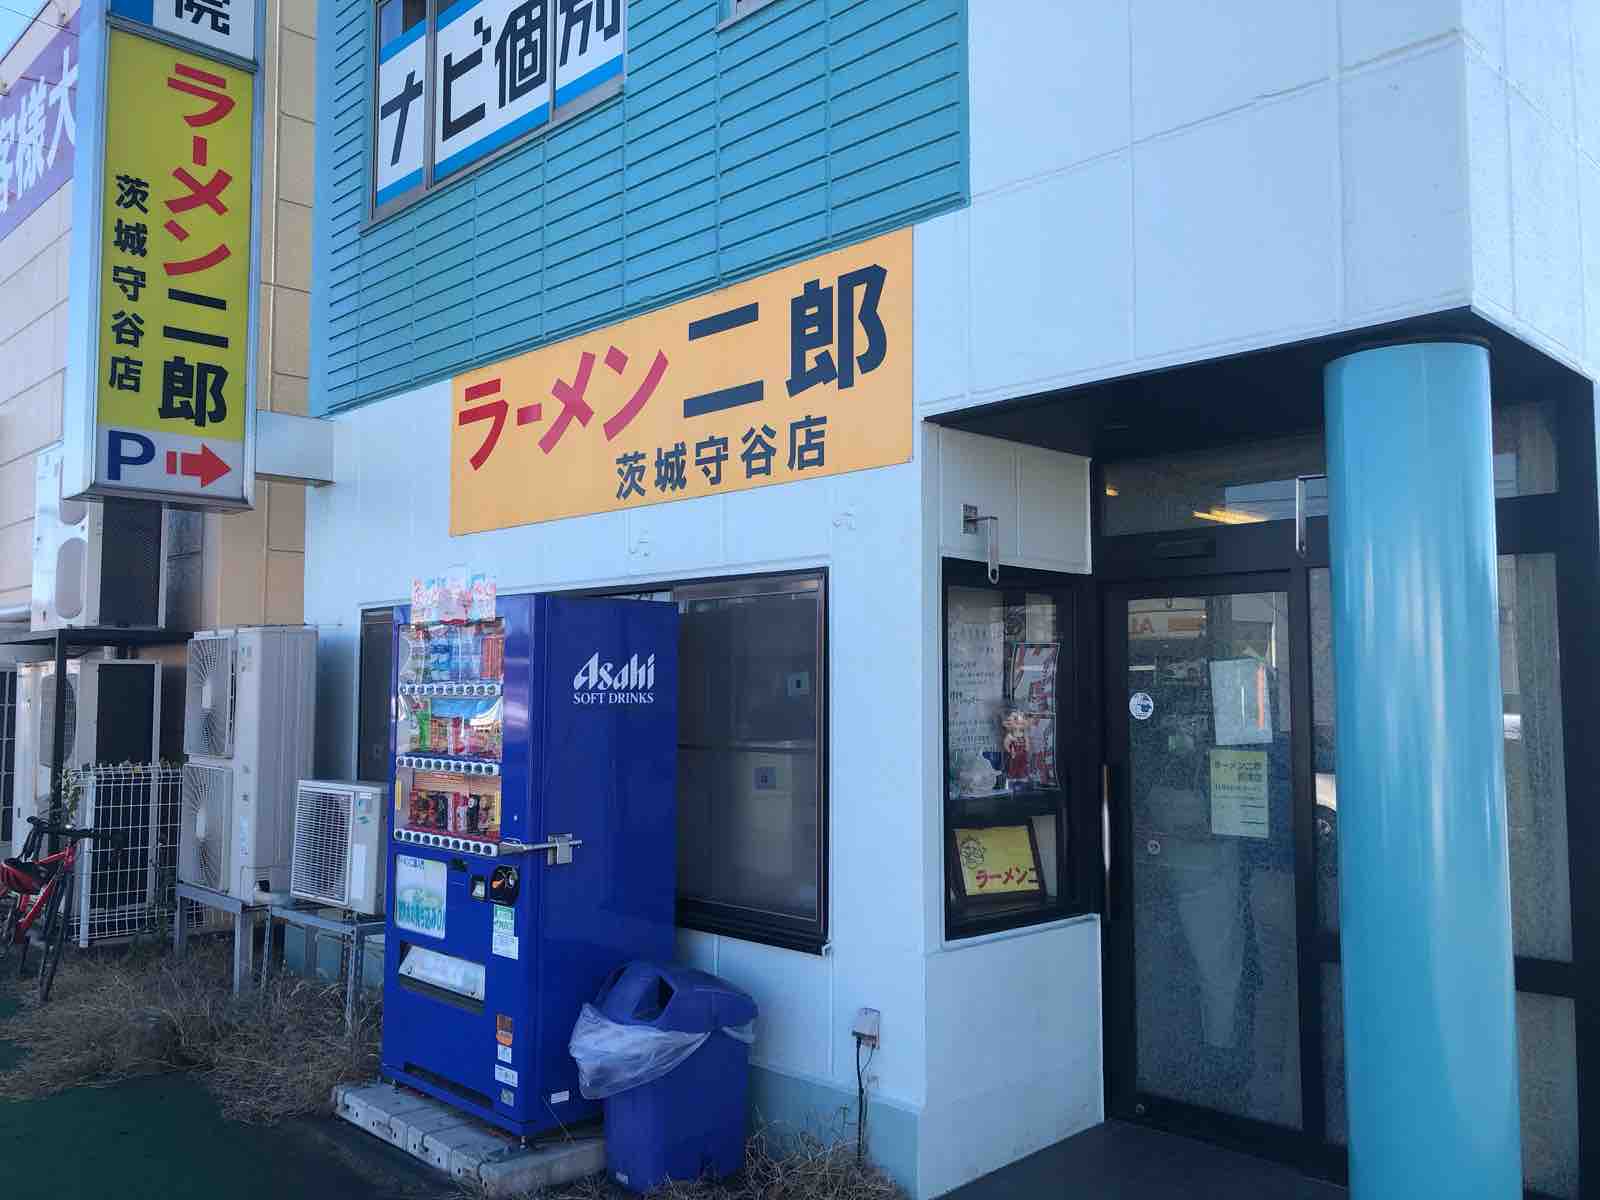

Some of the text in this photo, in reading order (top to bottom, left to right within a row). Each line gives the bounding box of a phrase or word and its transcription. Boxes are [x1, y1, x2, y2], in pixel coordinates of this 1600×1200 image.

[109, 174, 150, 394] 茨城守谷店
[158, 63, 236, 428] ラーメン二郎
[459, 263, 888, 472] ラーメン二郎
[107, 430, 156, 481] P
[615, 415, 828, 501] 茨城守谷店
[573, 652, 656, 690] Asahi
[573, 692, 656, 704] SOFT DRINKS
